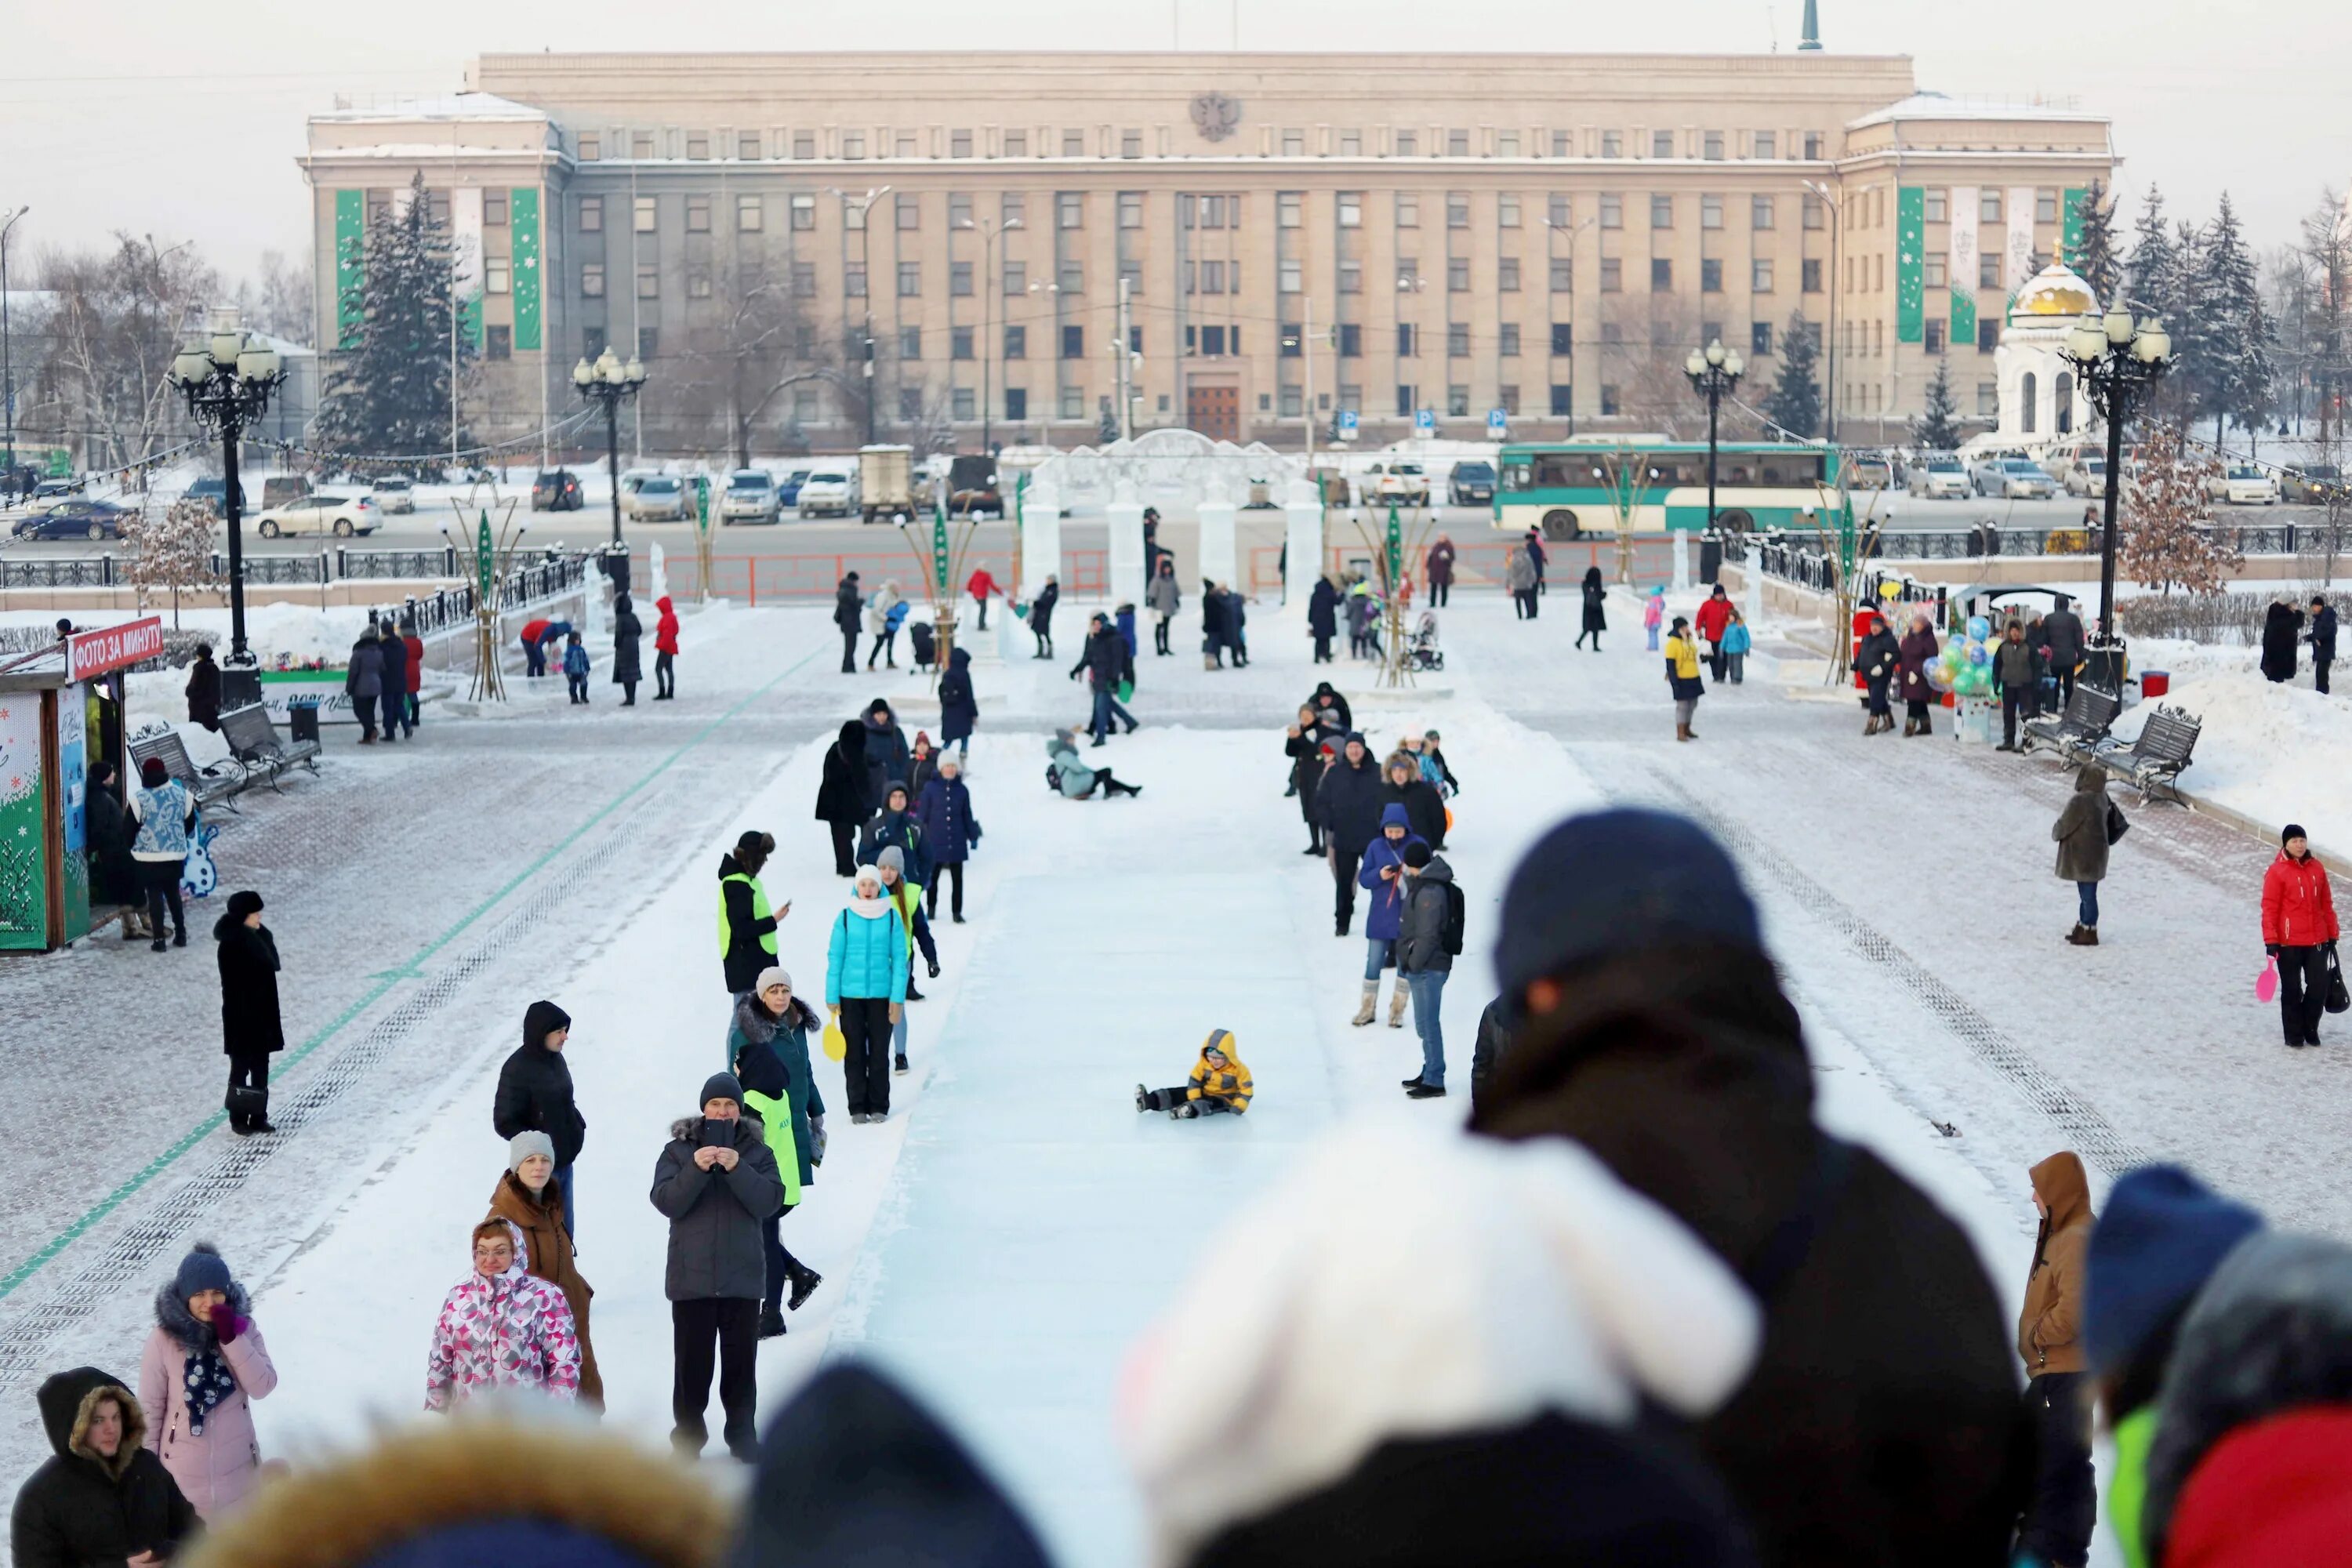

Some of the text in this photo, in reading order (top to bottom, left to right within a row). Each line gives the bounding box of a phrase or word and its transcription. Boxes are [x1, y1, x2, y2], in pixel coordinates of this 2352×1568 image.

[75, 623, 161, 670] ФОТО ЗА МИНУТУ
